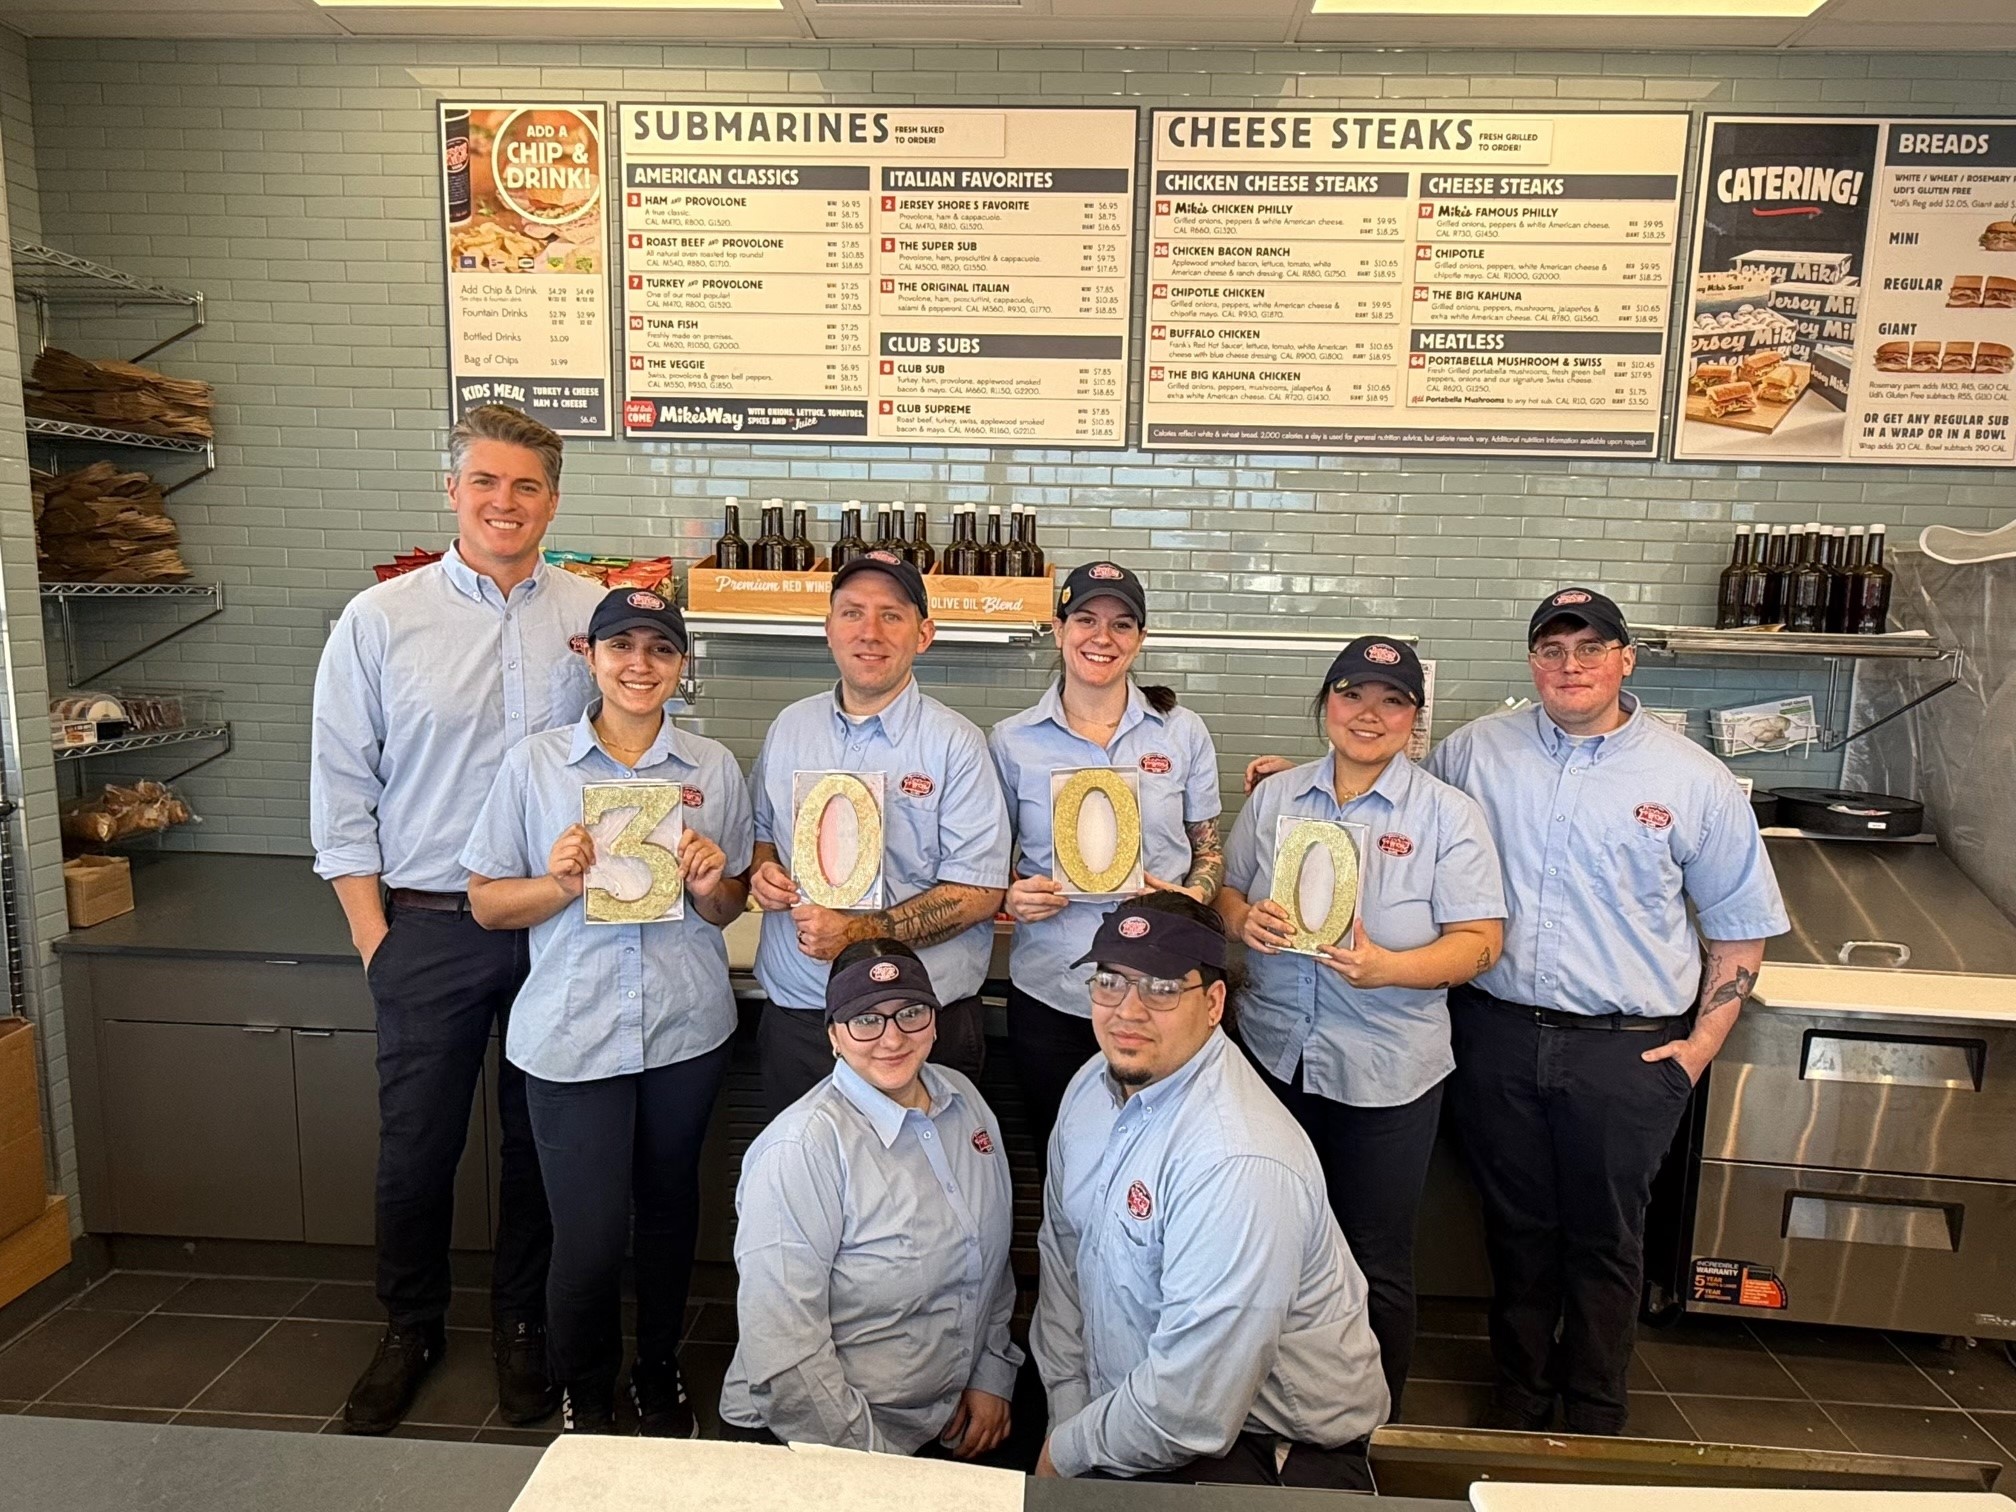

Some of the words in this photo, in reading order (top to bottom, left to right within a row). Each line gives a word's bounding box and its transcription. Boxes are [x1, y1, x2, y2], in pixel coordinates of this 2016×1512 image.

[527, 125, 554, 137] ADD
[559, 125, 568, 137] A
[635, 111, 888, 143] SUBMARINES
[1169, 117, 1311, 148] CHEESE
[1331, 118, 1473, 150] STEAKS
[1899, 134, 1989, 154] BREADS
[507, 142, 563, 164] CHIP
[572, 143, 588, 164] &
[507, 167, 590, 189] DRINK!
[635, 168, 721, 184] AMERICAN
[728, 169, 799, 185] CLASSICS
[890, 171, 955, 187] ITALIAN
[962, 172, 1052, 188] FAVORITES
[1165, 175, 1238, 191] CHICKEN
[1245, 175, 1309, 192] CHEESE
[1316, 176, 1378, 192] STEAKS
[1429, 177, 1494, 194] CHEESE
[1500, 178, 1563, 195] STEAKS
[1717, 166, 1863, 205] CATERING!
[645, 196, 667, 205] HAM
[686, 197, 746, 206] PROVOLONE
[900, 201, 934, 209] JERSEY
[983, 201, 1029, 210] FAVORITE
[1212, 205, 1254, 213] CHICKEN
[1258, 205, 1293, 214] PHILLY
[1476, 208, 1518, 217] FAMOUS
[1523, 208, 1558, 217] PHILLY
[647, 238, 677, 246] ROAST
[681, 238, 705, 247] BEEF
[723, 239, 783, 248] PROVOLONE
[1889, 232, 1919, 244] MINI
[899, 241, 918, 250] THE
[922, 242, 953, 250] SUPER
[958, 242, 977, 251] SUB
[1173, 247, 1214, 255] CHICKEN
[1218, 247, 1252, 256] BACON
[1256, 248, 1290, 256] RANCH
[646, 279, 684, 288] TURKEY
[703, 280, 762, 289] PROVOLONE
[898, 283, 917, 291] THE
[921, 283, 968, 292] ORIGINAL
[973, 284, 1009, 292] ITALIAN
[1884, 278, 1942, 290] REGULAR
[461, 285, 477, 294] Add
[483, 285, 502, 295] Chip
[505, 285, 512, 294] &
[515, 285, 537, 294] Drink
[1171, 288, 1219, 297] CHIPOTLE
[1223, 289, 1264, 297] CHICKEN
[1768, 291, 1821, 315] Jersey
[463, 308, 498, 317] Fountain
[502, 308, 528, 317] Drinks
[647, 320, 674, 328] TUNA
[678, 320, 698, 329] FISH
[1879, 323, 1917, 335] GIANT
[464, 332, 492, 341] Bottled
[496, 332, 521, 341] Drinks
[1170, 329, 1214, 338] BUFFALO
[1219, 330, 1260, 338] CHICKEN
[889, 337, 930, 352] CLUB
[938, 338, 979, 353] SUBS
[1420, 334, 1504, 349] MEATLESS
[464, 355, 480, 366] Bag
[483, 354, 492, 363] of
[495, 355, 518, 366] Chips
[648, 360, 666, 368] THE
[670, 360, 704, 369] VEGGIE
[1429, 356, 1493, 365] PORTABELLA
[1497, 357, 1559, 366] MUSHROOM
[1563, 358, 1569, 366] &
[1574, 358, 1601, 367] SWISS
[1168, 371, 1187, 379] THE
[1191, 371, 1208, 379] BIG
[1213, 371, 1255, 380] KAHUNA
[1259, 372, 1300, 380] CHICKEN
[462, 383, 491, 403] KIDS
[493, 383, 525, 403] MEAL
[533, 387, 561, 395] TURKEY
[564, 387, 570, 395] &
[572, 388, 599, 396] CHEESE
[533, 399, 550, 407] HAM
[552, 399, 559, 408] &
[561, 399, 587, 408] CHEESE
[897, 404, 920, 413] CLUB
[925, 405, 971, 414] SUPREME
[628, 411, 652, 422] COME
[797, 409, 826, 418] LETTUCE,
[828, 409, 864, 417] TOMATOES,
[1864, 413, 1879, 423] OR
[1883, 413, 1903, 423] GET
[1907, 414, 1930, 424] ANY
[1934, 414, 1983, 425] REGULAR
[1988, 415, 2009, 425] SUB
[748, 417, 770, 425] SPICES
[772, 417, 786, 425] AND
[792, 418, 817, 430] Juice
[1863, 427, 1875, 437] IN
[1879, 428, 1885, 437] A
[1892, 428, 1924, 438] WRAP
[1928, 428, 1943, 438] OR
[1947, 429, 1959, 439] IN
[1963, 429, 1970, 439] A
[1975, 429, 2006, 439] BOWL
[715, 576, 780, 593] Premium
[782, 580, 801, 592] RED
[806, 581, 832, 593] WINE
[931, 597, 959, 610] OLIVE
[963, 597, 978, 610] OIL
[982, 597, 1023, 613] Blend
[584, 786, 680, 922] 3
[794, 774, 882, 908] 0
[1054, 769, 1140, 893] 0
[1271, 822, 1357, 955] 0
[1696, 1267, 1738, 1276] WARRANTY
[1694, 1275, 1705, 1285] 5
[1694, 1288, 1705, 1298] 7
